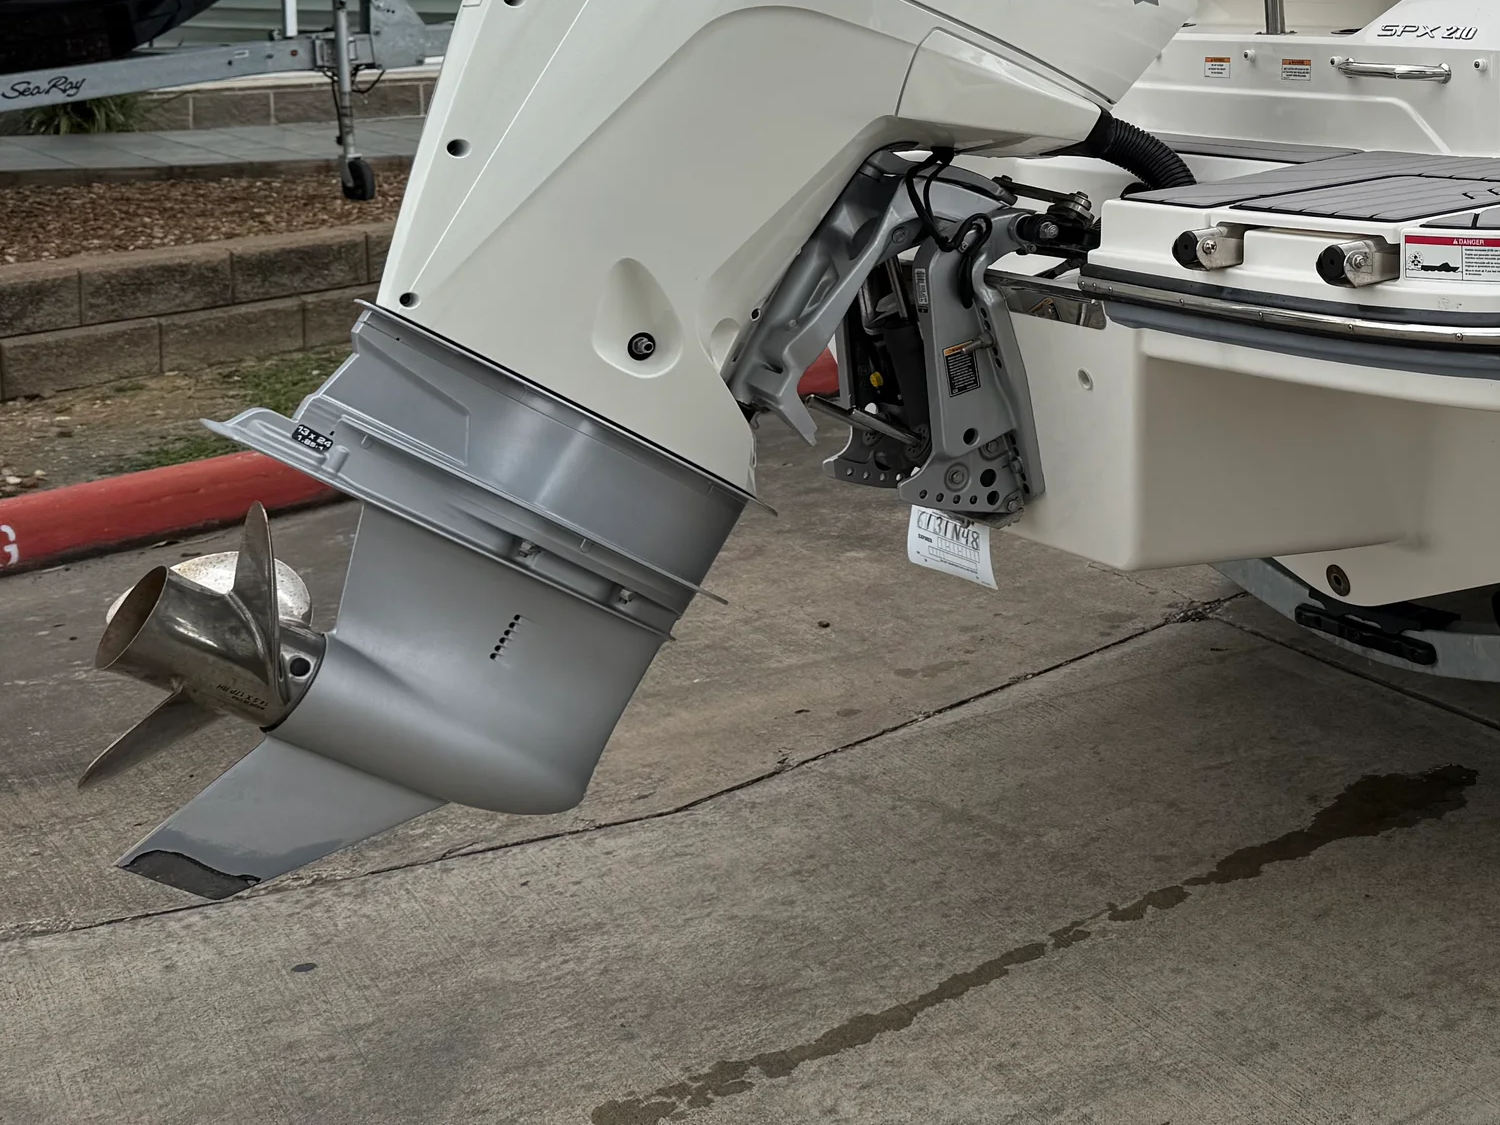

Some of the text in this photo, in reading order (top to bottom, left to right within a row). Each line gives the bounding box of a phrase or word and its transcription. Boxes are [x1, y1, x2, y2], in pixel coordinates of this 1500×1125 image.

[1376, 24, 1479, 41] SPX 210
[1, 75, 87, 100] Sea Ray
[1458, 238, 1485, 246] DANGER
[297, 425, 311, 436] 13
[316, 436, 332, 448] 24
